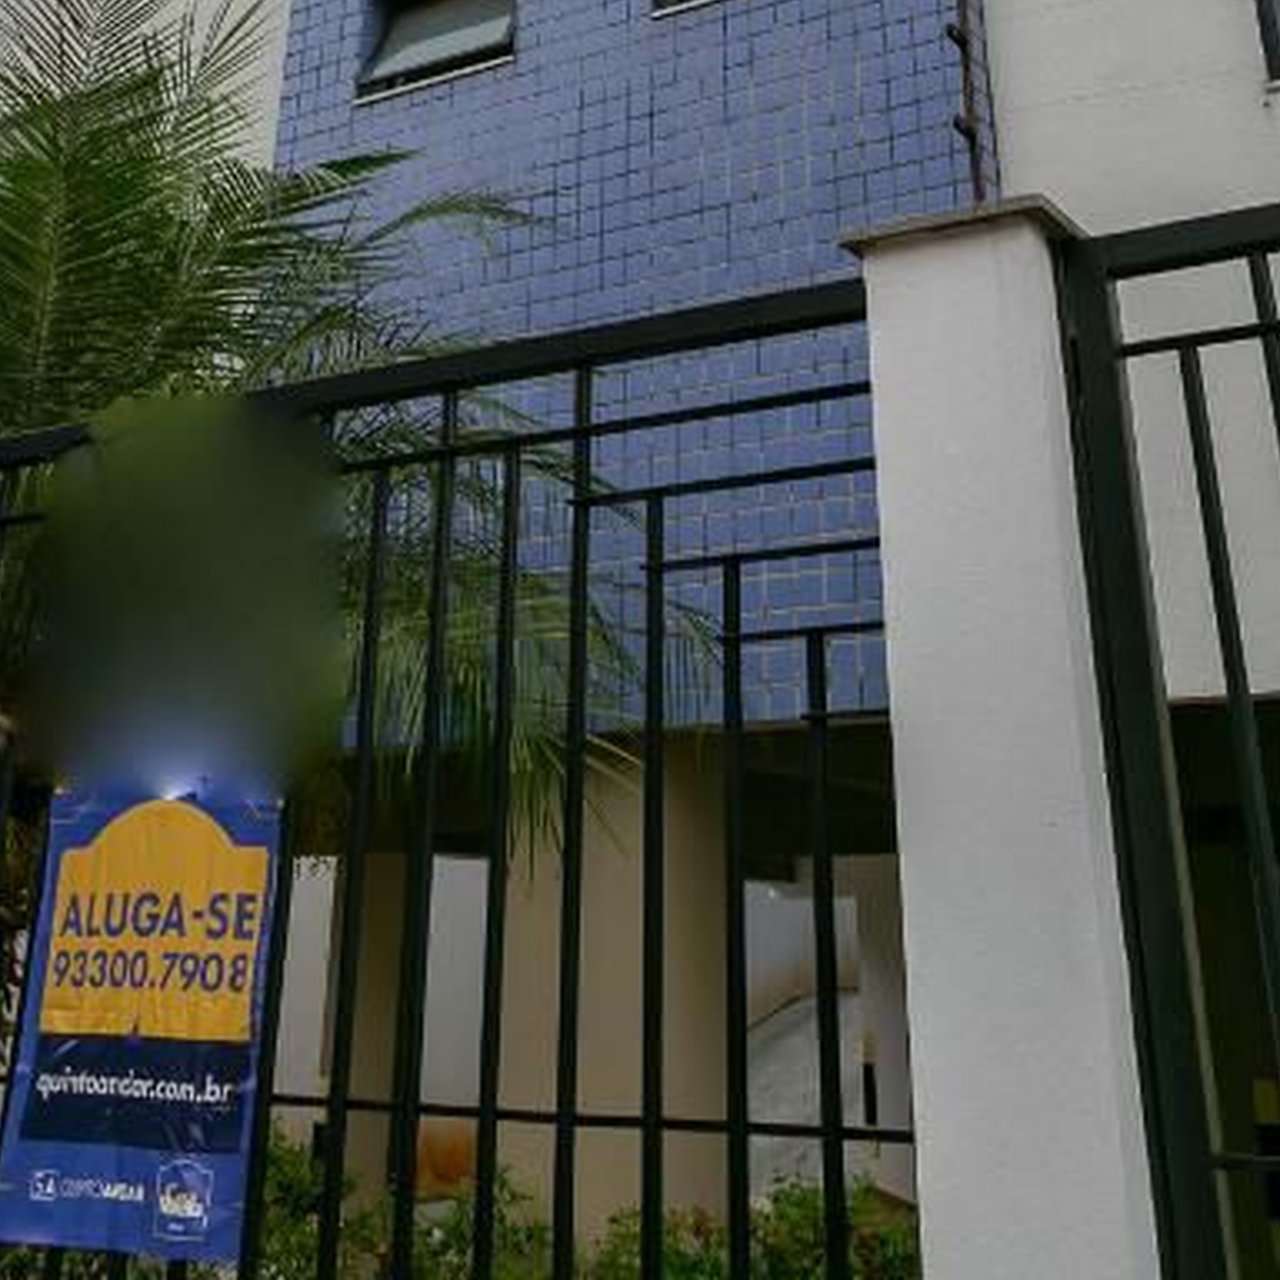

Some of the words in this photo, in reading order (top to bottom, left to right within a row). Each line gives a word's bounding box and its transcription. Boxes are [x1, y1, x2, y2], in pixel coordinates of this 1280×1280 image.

[60, 893, 257, 940] ALUGA-SE
[54, 950, 247, 992] 93300.7908
[36, 1067, 233, 1102] quintoandar.com.br
